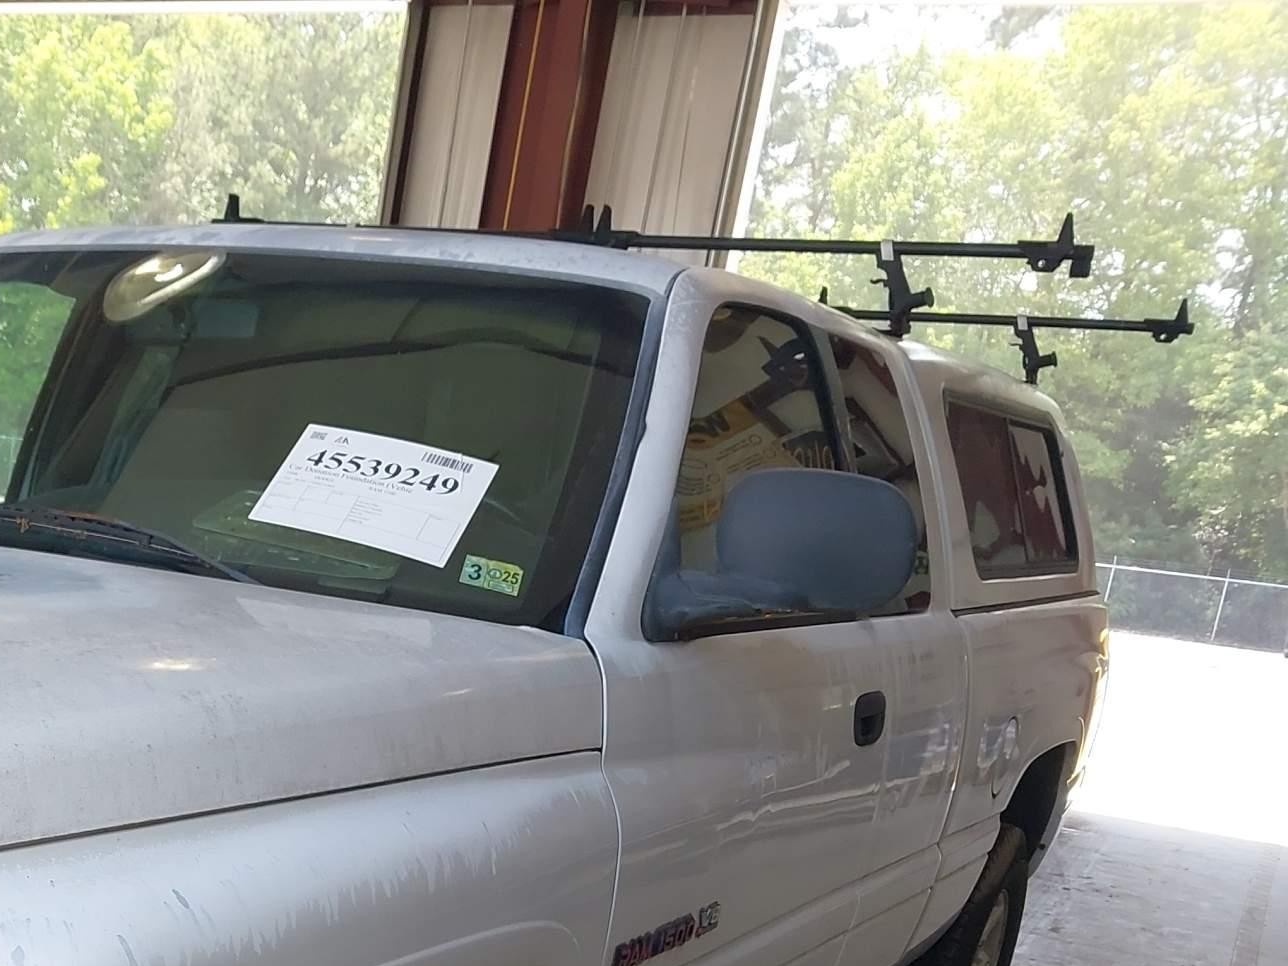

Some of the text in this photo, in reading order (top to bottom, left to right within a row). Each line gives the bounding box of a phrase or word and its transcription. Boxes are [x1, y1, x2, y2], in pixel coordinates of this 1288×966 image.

[306, 449, 460, 495] 45539249
[468, 564, 520, 585] 3 25
